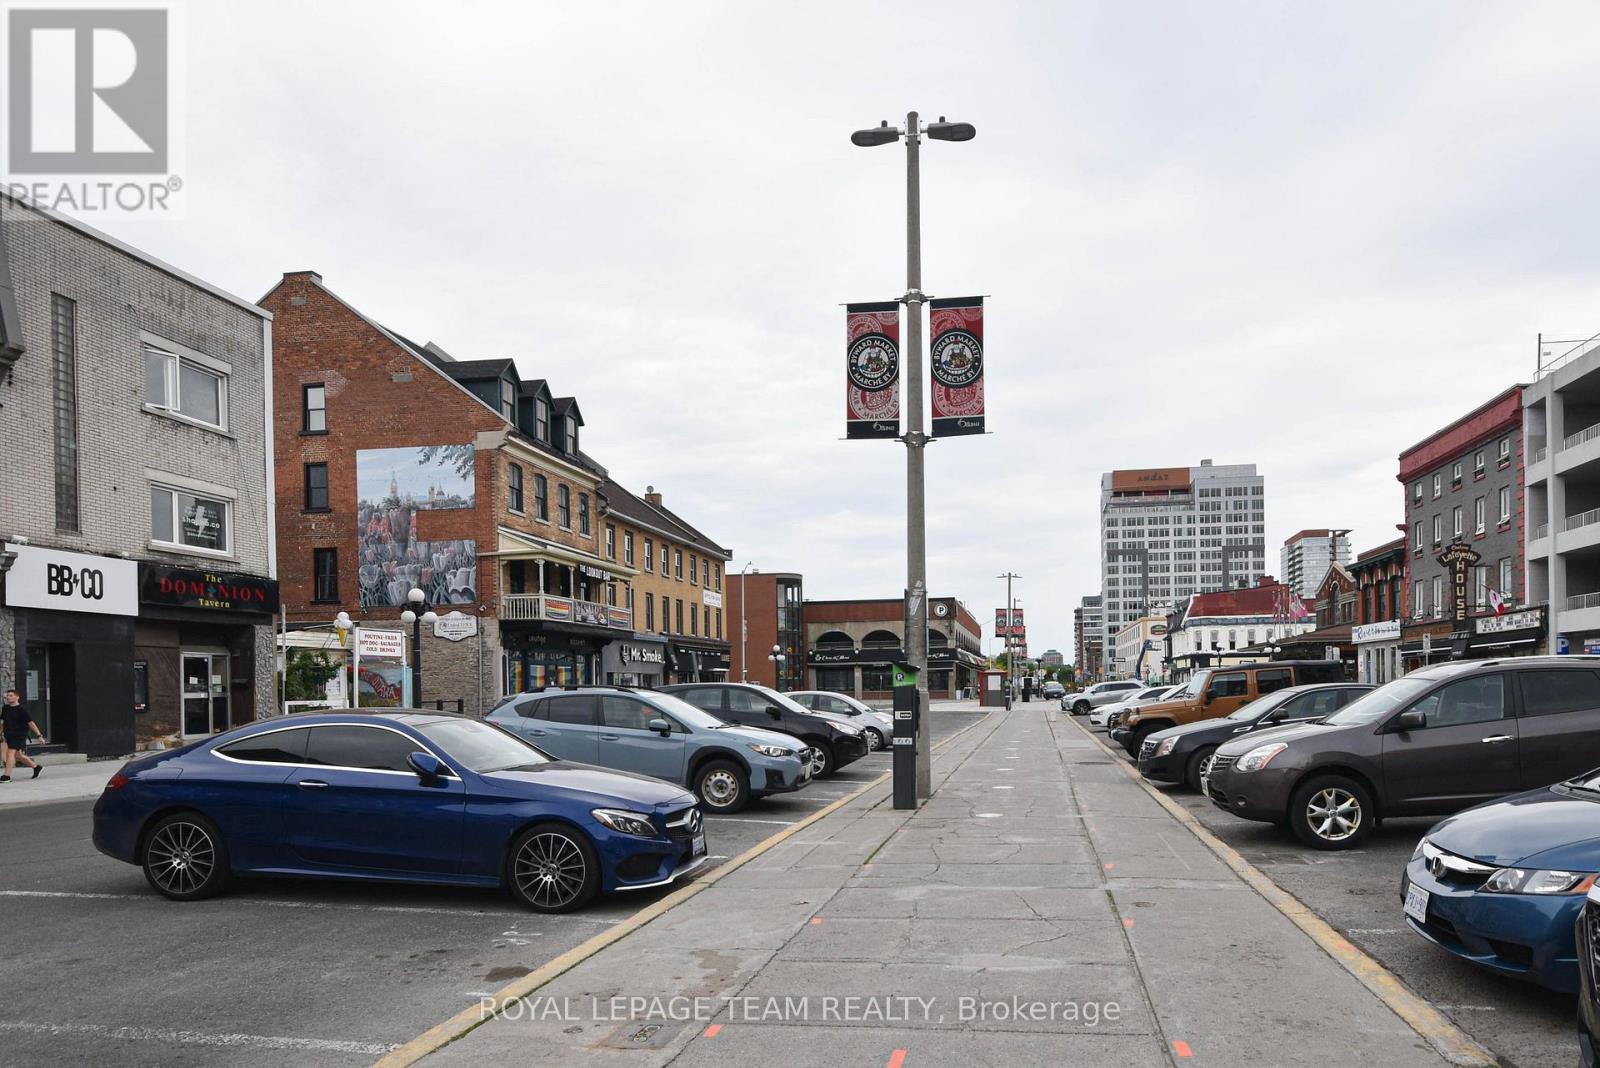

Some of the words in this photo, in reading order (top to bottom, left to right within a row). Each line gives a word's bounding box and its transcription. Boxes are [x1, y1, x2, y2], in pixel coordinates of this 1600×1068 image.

[851, 340, 872, 363] BYWARD
[874, 340, 896, 361] MARKET
[934, 336, 955, 360] BYWARD
[957, 336, 980, 358] MARKET
[883, 372, 892, 384] BY
[967, 369, 976, 380] BY
[1441, 551, 1478, 562] Lafayette
[47, 563, 73, 596] BB
[80, 568, 103, 600] CO
[205, 574, 222, 583] The
[1456, 561, 1465, 620] HOUSE
[198, 598, 230, 608] Tavern
[1557, 638, 1569, 653] P
[631, 648, 641, 661] Mr.
